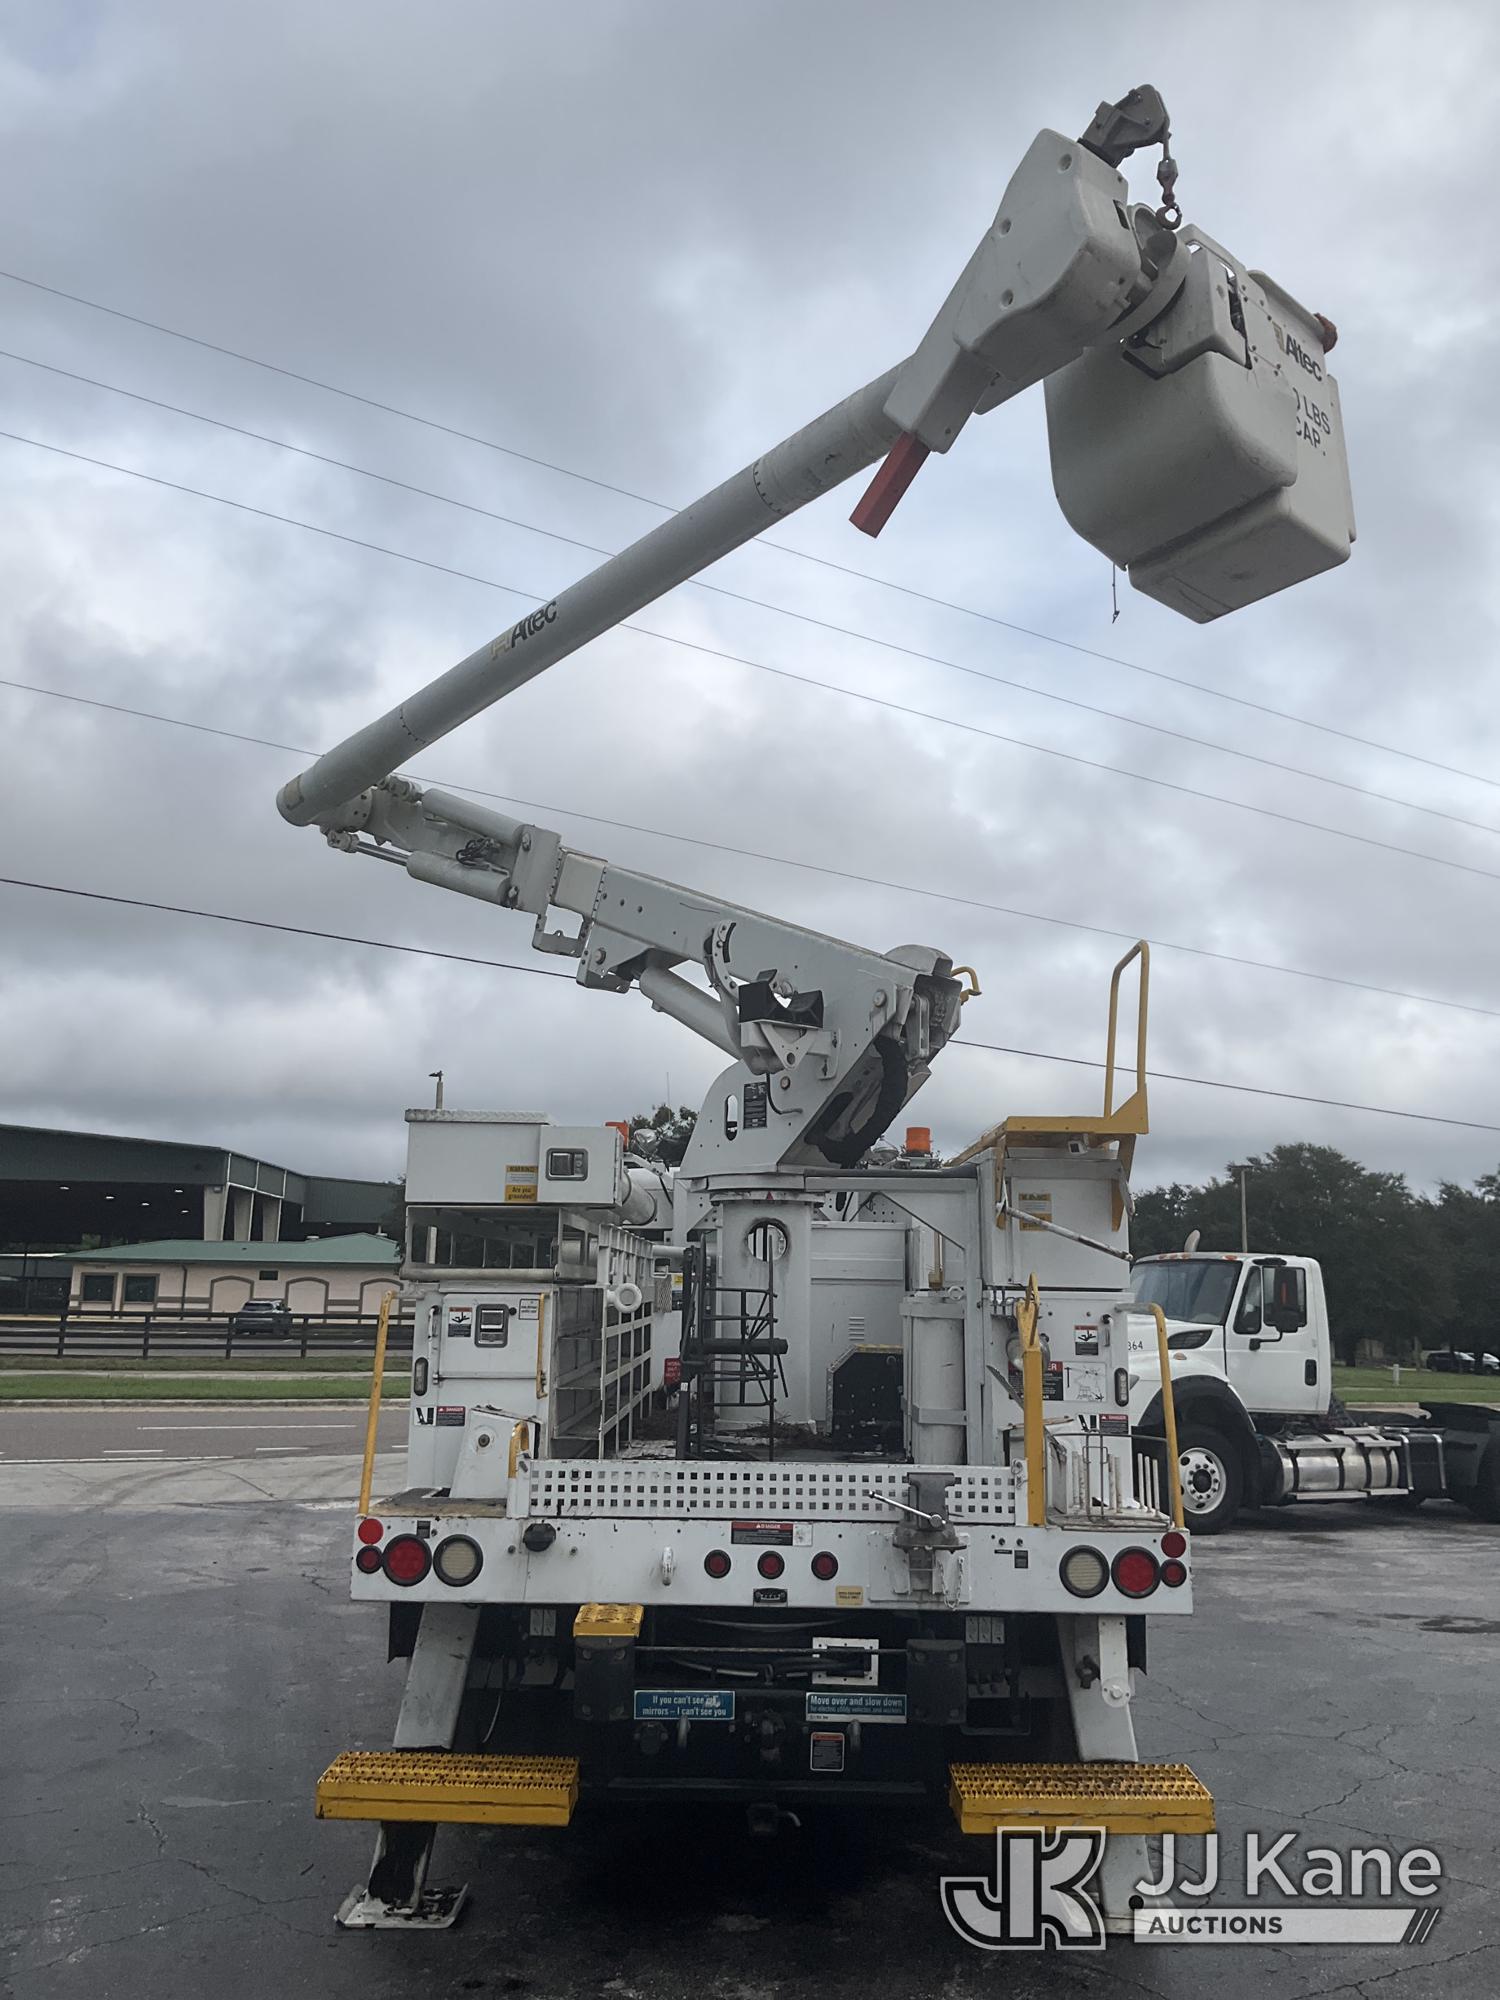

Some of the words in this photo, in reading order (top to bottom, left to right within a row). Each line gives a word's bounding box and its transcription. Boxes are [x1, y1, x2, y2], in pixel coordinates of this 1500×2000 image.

[1286, 334, 1322, 382] Altec
[1303, 395, 1331, 435] LBS
[511, 600, 557, 649] Altec
[642, 1707, 669, 1716] mirrors
[681, 1706, 699, 1716] can't
[700, 1708, 712, 1716] see
[713, 1708, 727, 1717] you
[652, 1695, 658, 1704] If
[659, 1697, 672, 1706] you
[673, 1695, 691, 1704] can't
[692, 1697, 704, 1705] see
[810, 1695, 829, 1705] Move
[831, 1697, 847, 1705] over
[849, 1697, 863, 1706] and
[865, 1697, 881, 1706] slow
[883, 1698, 903, 1707] down
